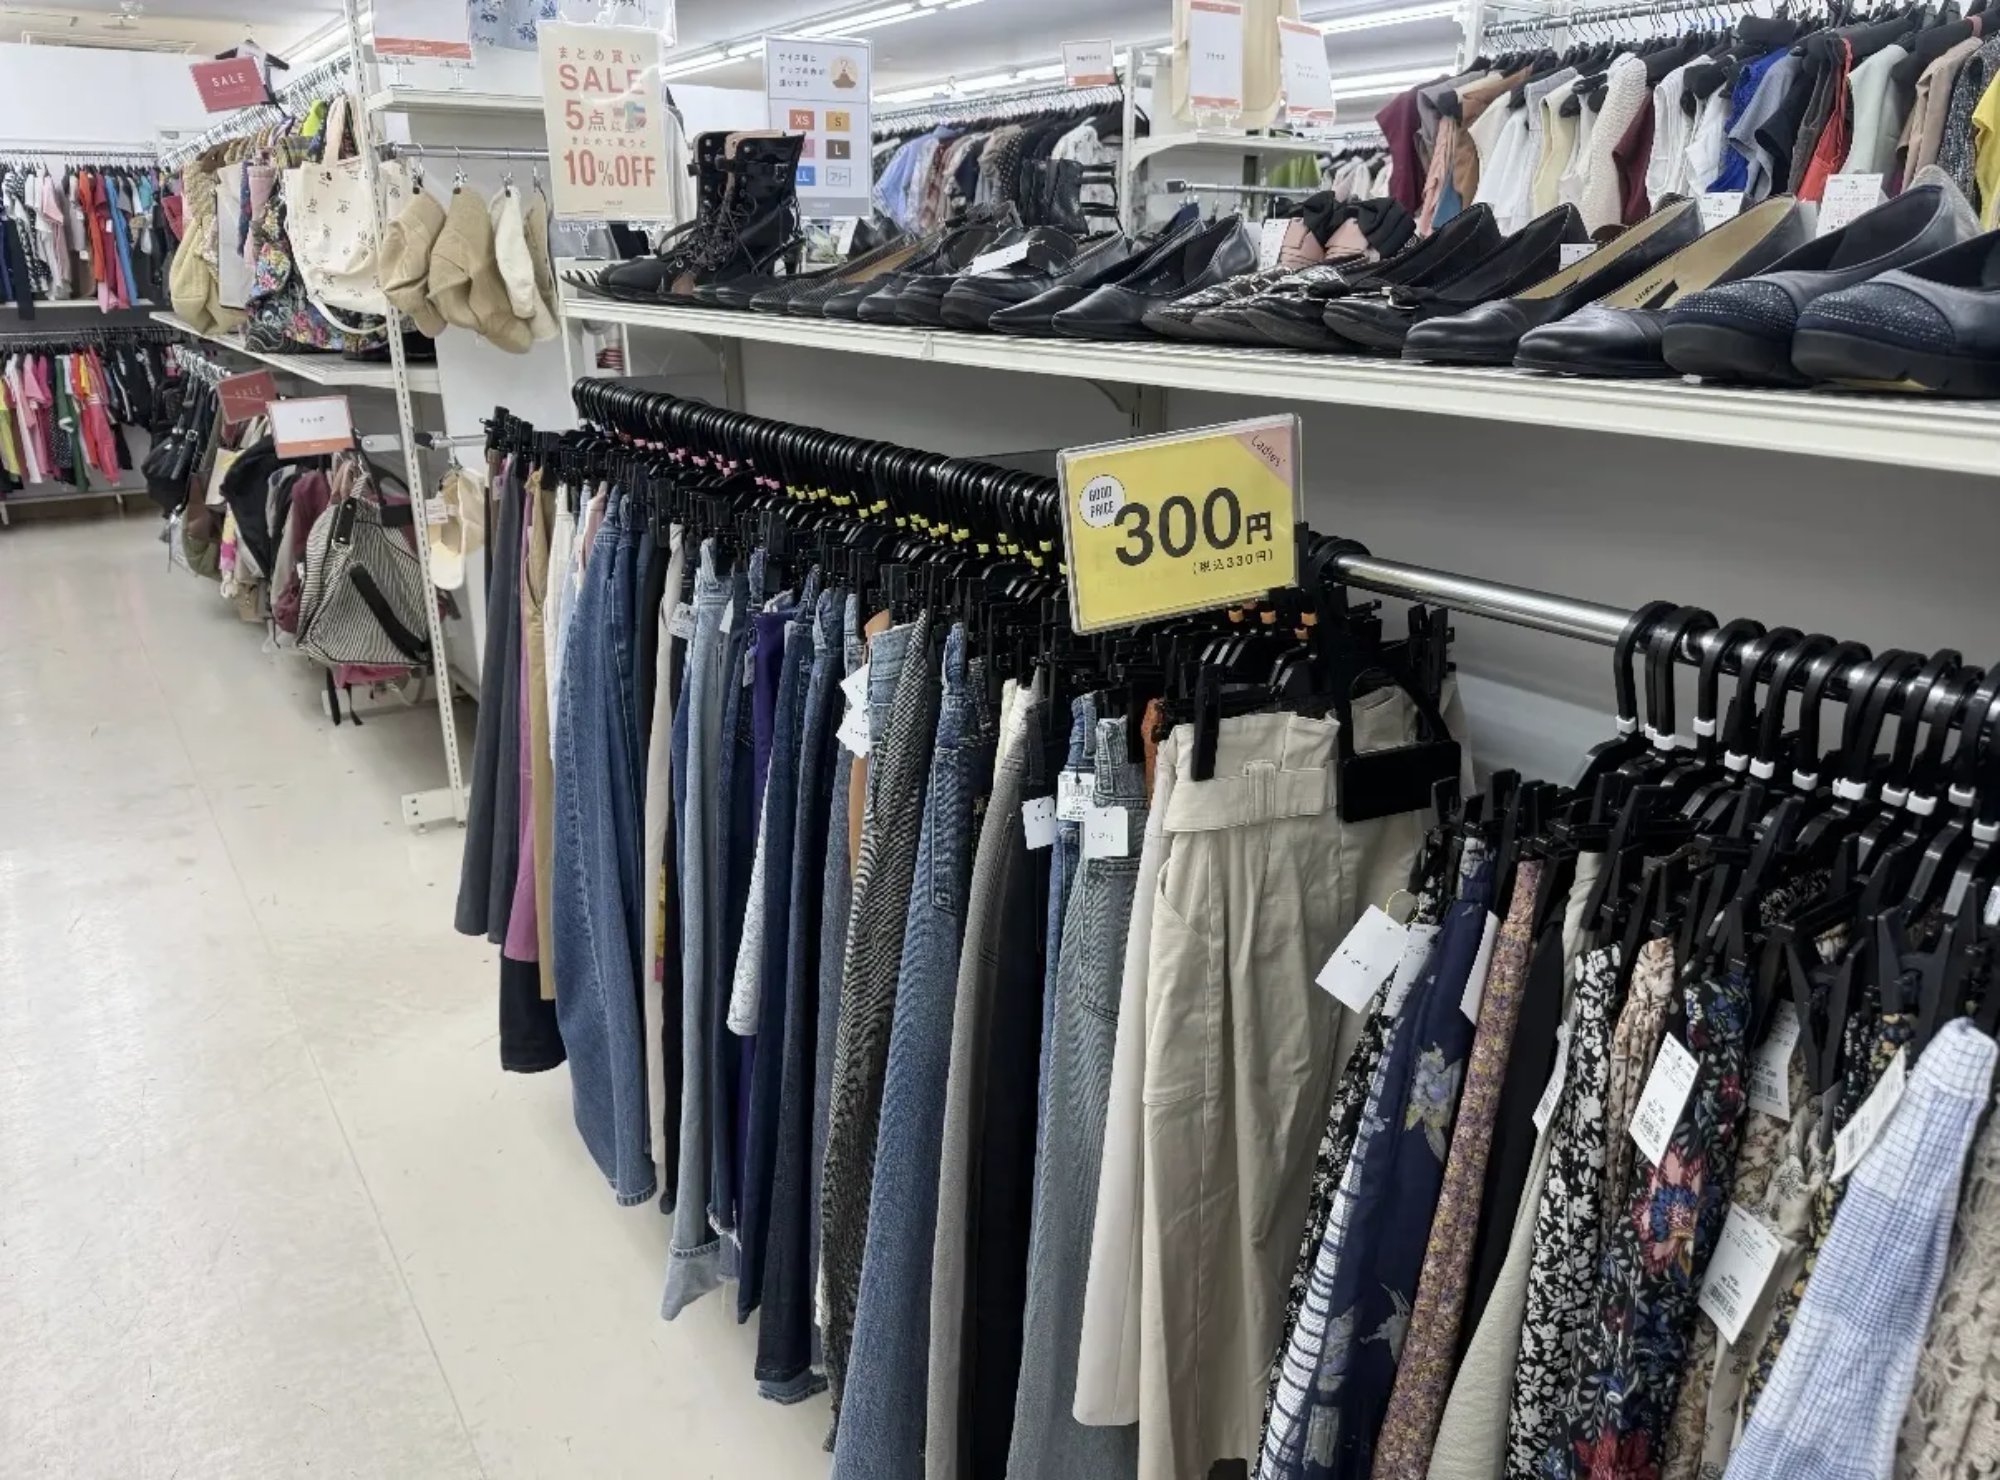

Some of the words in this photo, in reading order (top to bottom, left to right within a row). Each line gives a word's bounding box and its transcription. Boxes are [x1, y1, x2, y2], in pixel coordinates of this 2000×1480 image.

[558, 46, 641, 63] まとめ買い
[212, 73, 245, 87] SALE
[558, 64, 645, 95] SALE
[795, 114, 810, 126] XS
[835, 117, 842, 127] S
[835, 144, 841, 155] L
[564, 149, 656, 187] 10%OFF
[1089, 485, 1112, 502] GOOD
[1090, 501, 1115, 518] PRICE
